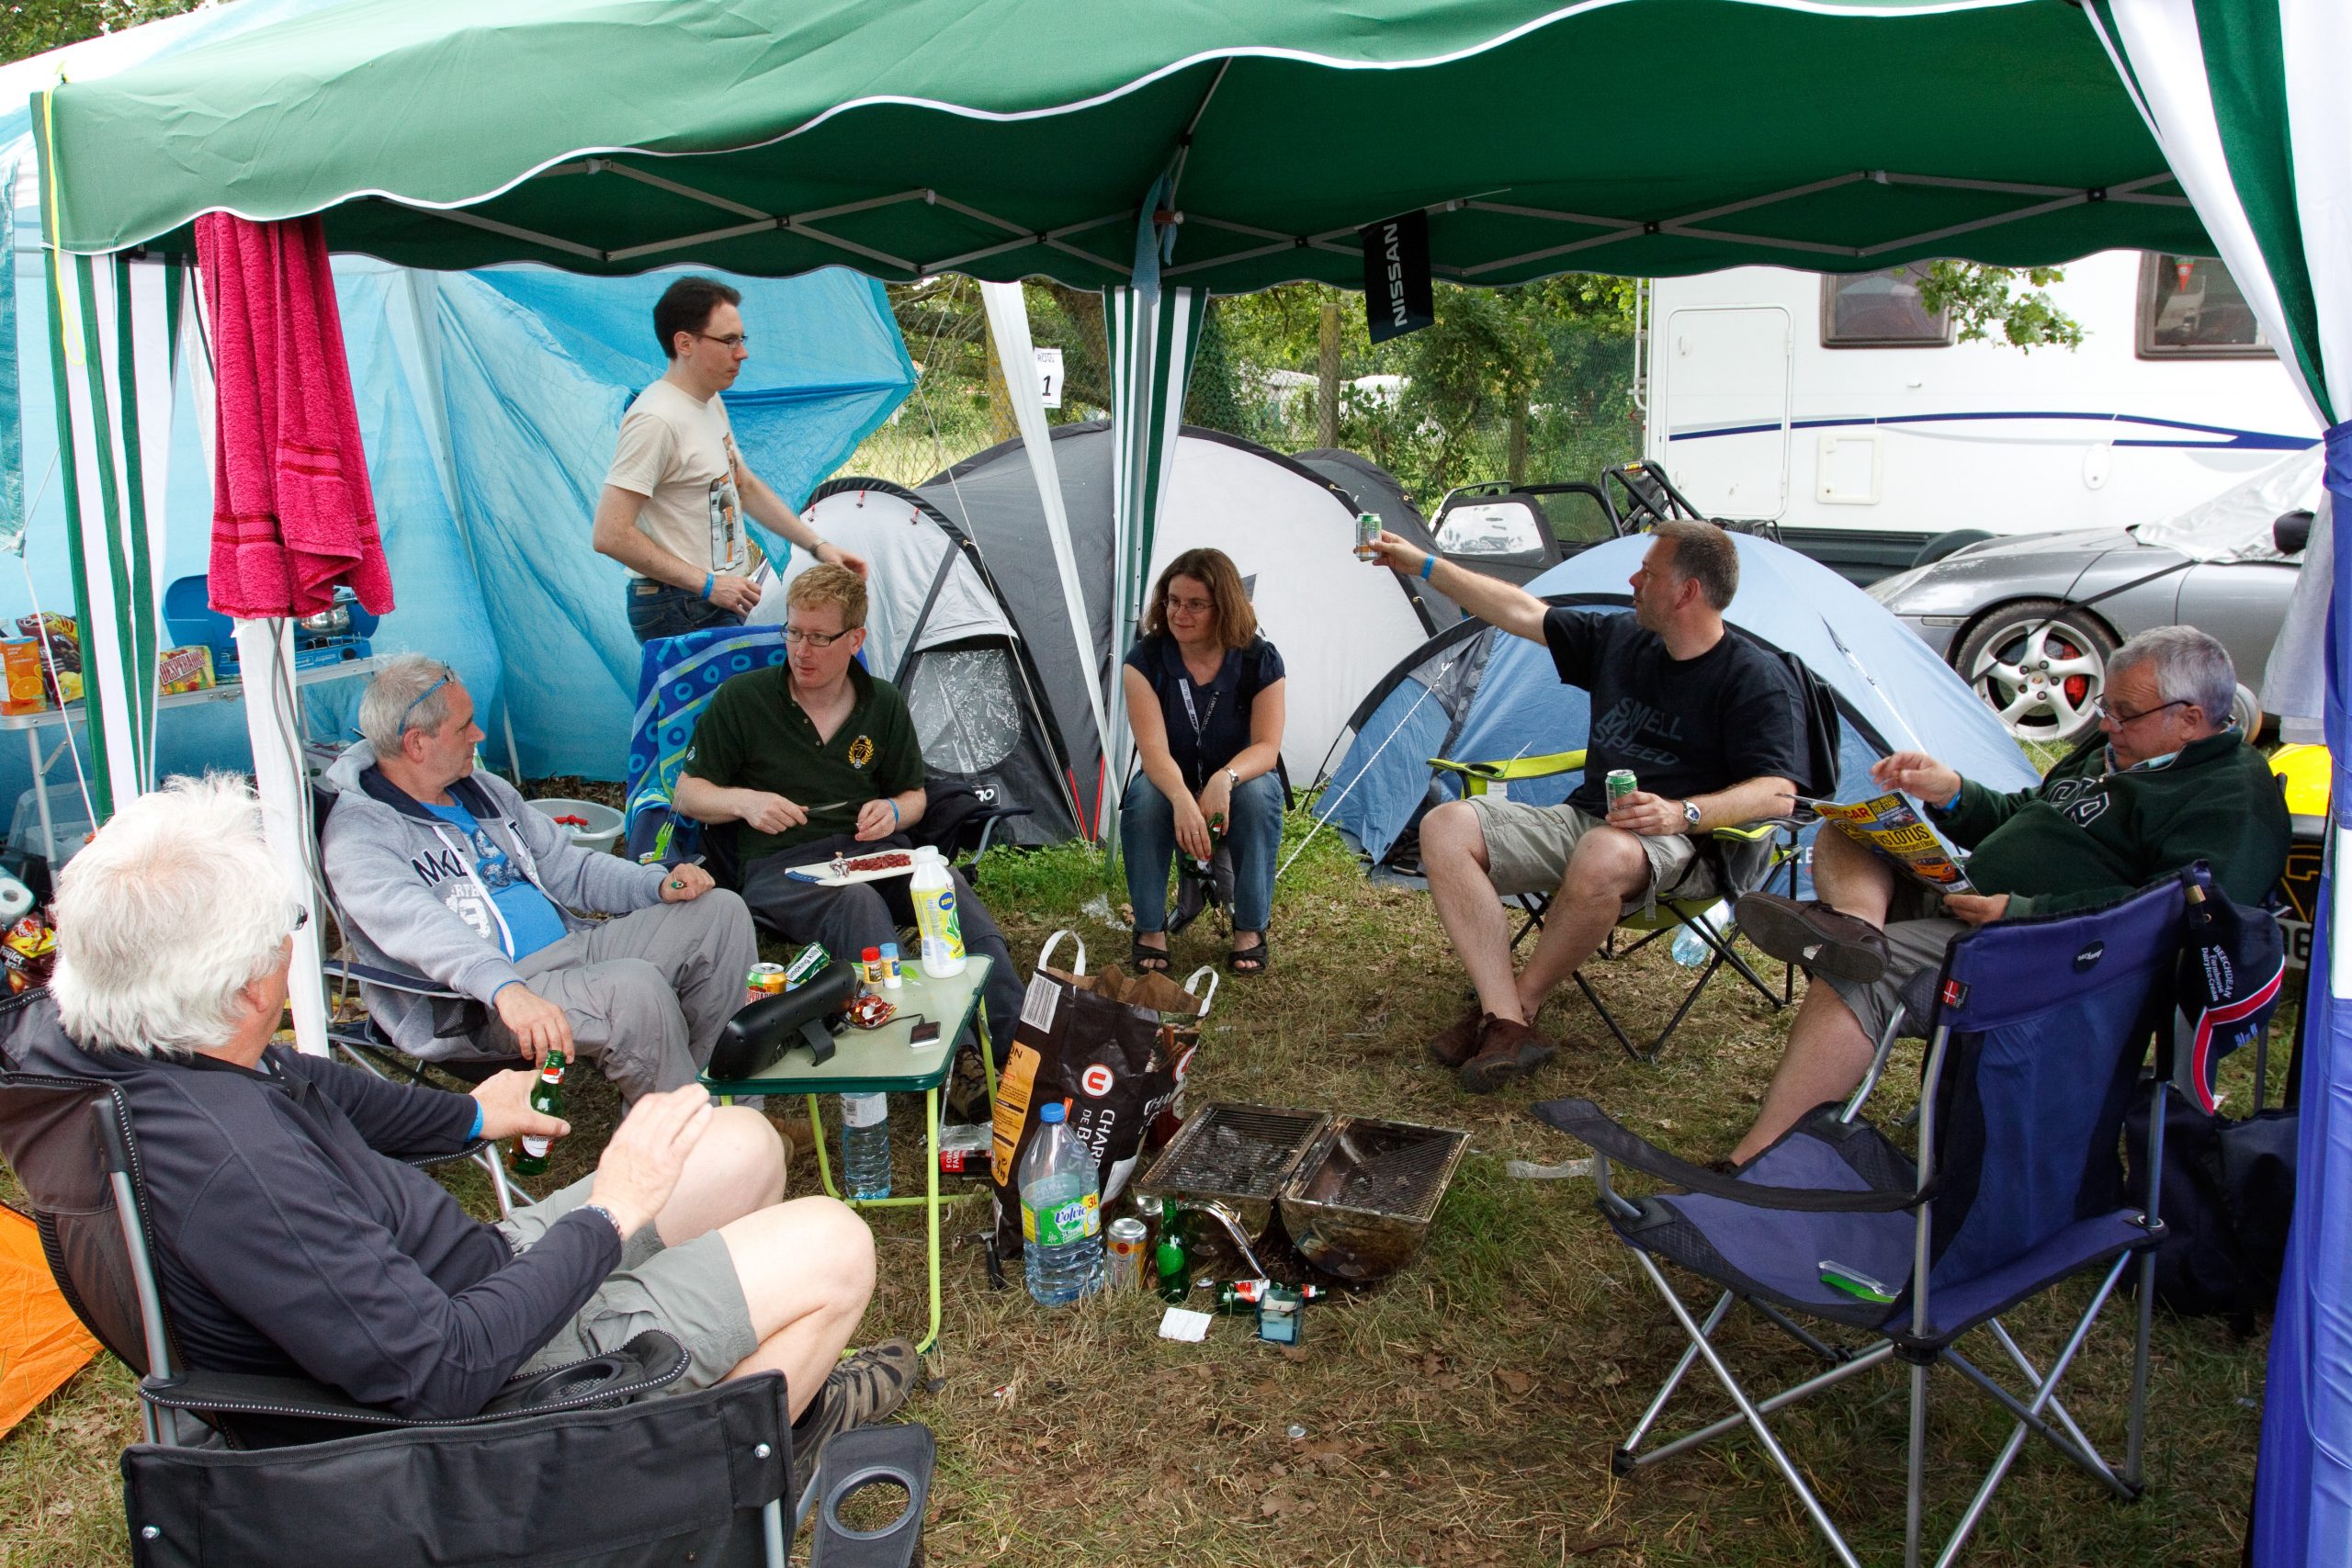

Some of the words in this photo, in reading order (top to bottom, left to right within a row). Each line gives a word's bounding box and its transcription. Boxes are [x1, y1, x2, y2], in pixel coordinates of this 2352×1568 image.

[1383, 223, 1408, 327] NISSAN
[1042, 375, 1051, 396] 1
[159, 650, 207, 685] DESPERADOS
[1616, 697, 1683, 741] SMELL
[1592, 722, 1680, 765] SPEED
[1889, 826, 1930, 846] LOTUS
[787, 958, 811, 979] Smoking
[808, 948, 820, 961] kills
[2201, 947, 2210, 966] Dairy
[2209, 978, 2219, 1001] Cream
[2211, 954, 2223, 993] Farmhouse
[2212, 944, 2233, 998] BEECHDEAN
[1080, 1109, 1092, 1125] DE
[1055, 1206, 1088, 1224] Volvic
